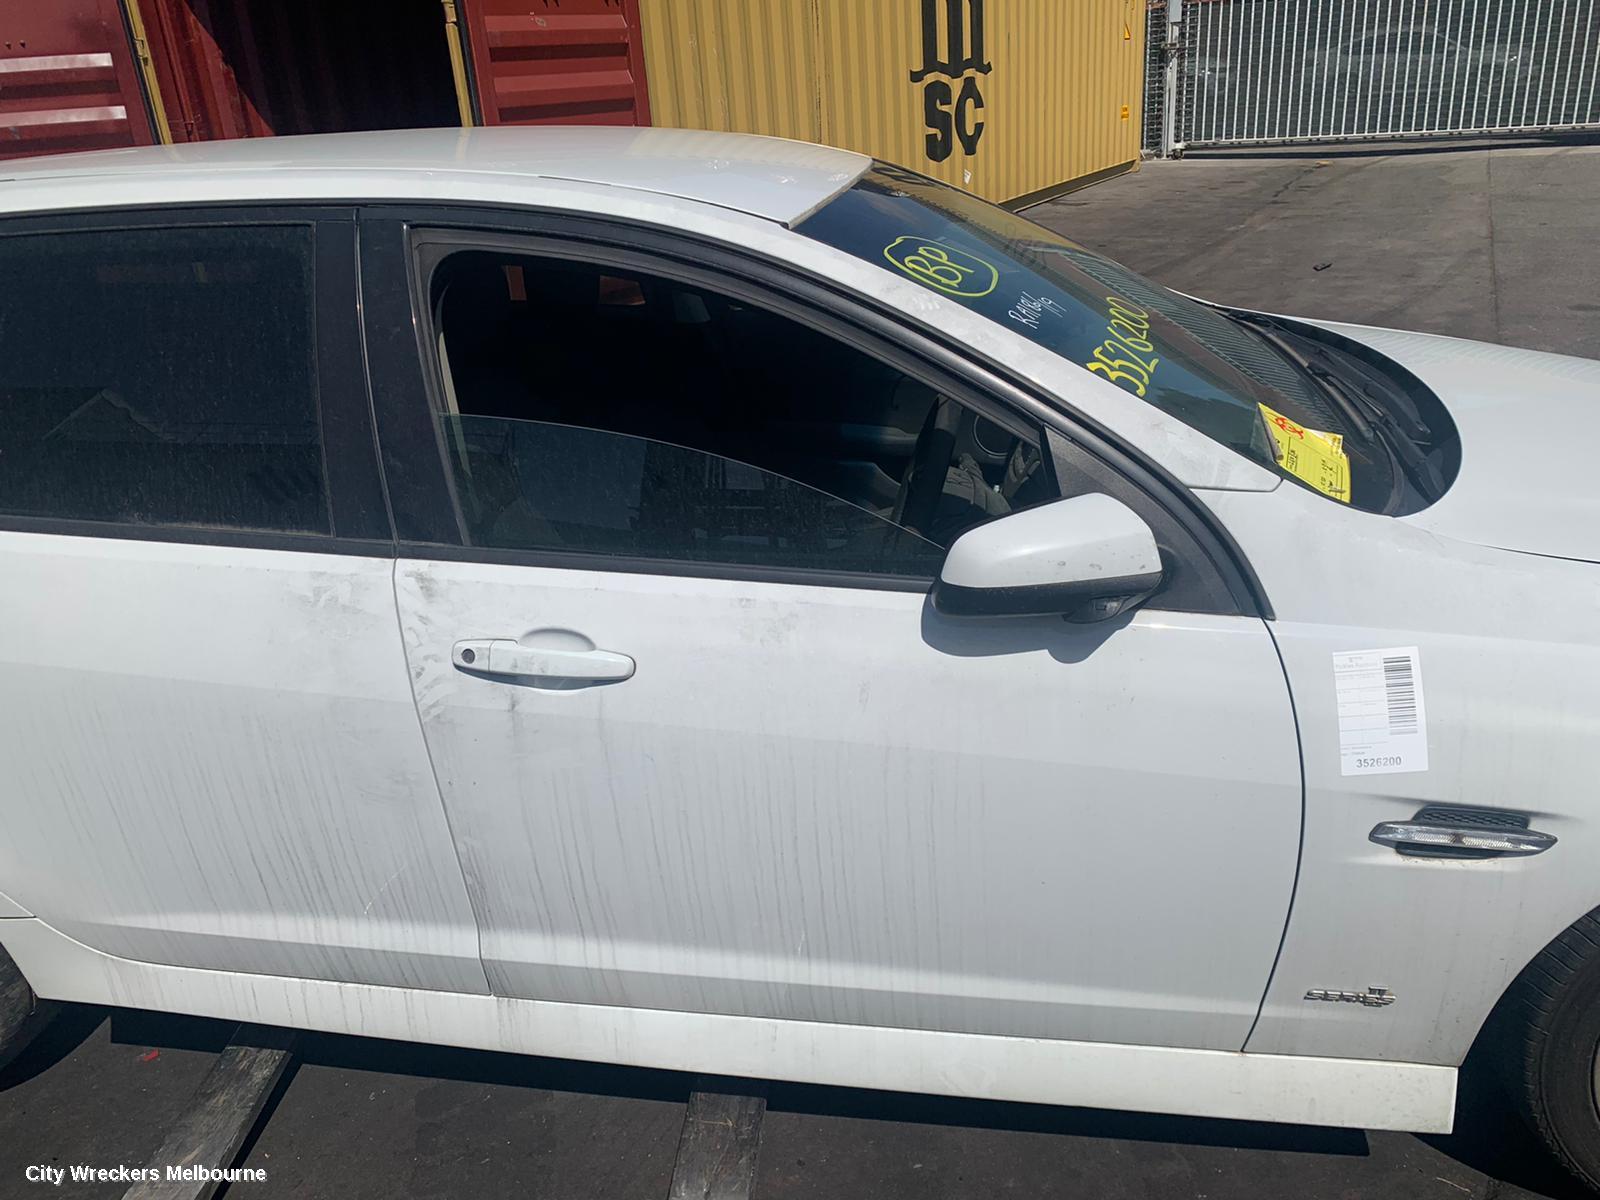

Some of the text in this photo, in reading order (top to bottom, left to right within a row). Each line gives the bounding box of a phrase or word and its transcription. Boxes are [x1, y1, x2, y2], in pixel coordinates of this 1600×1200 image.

[904, 246, 974, 287] BP
[1086, 297, 1159, 397] 3526200
[1356, 756, 1402, 768] 3526200
[1303, 989, 1397, 1006] SERIES
